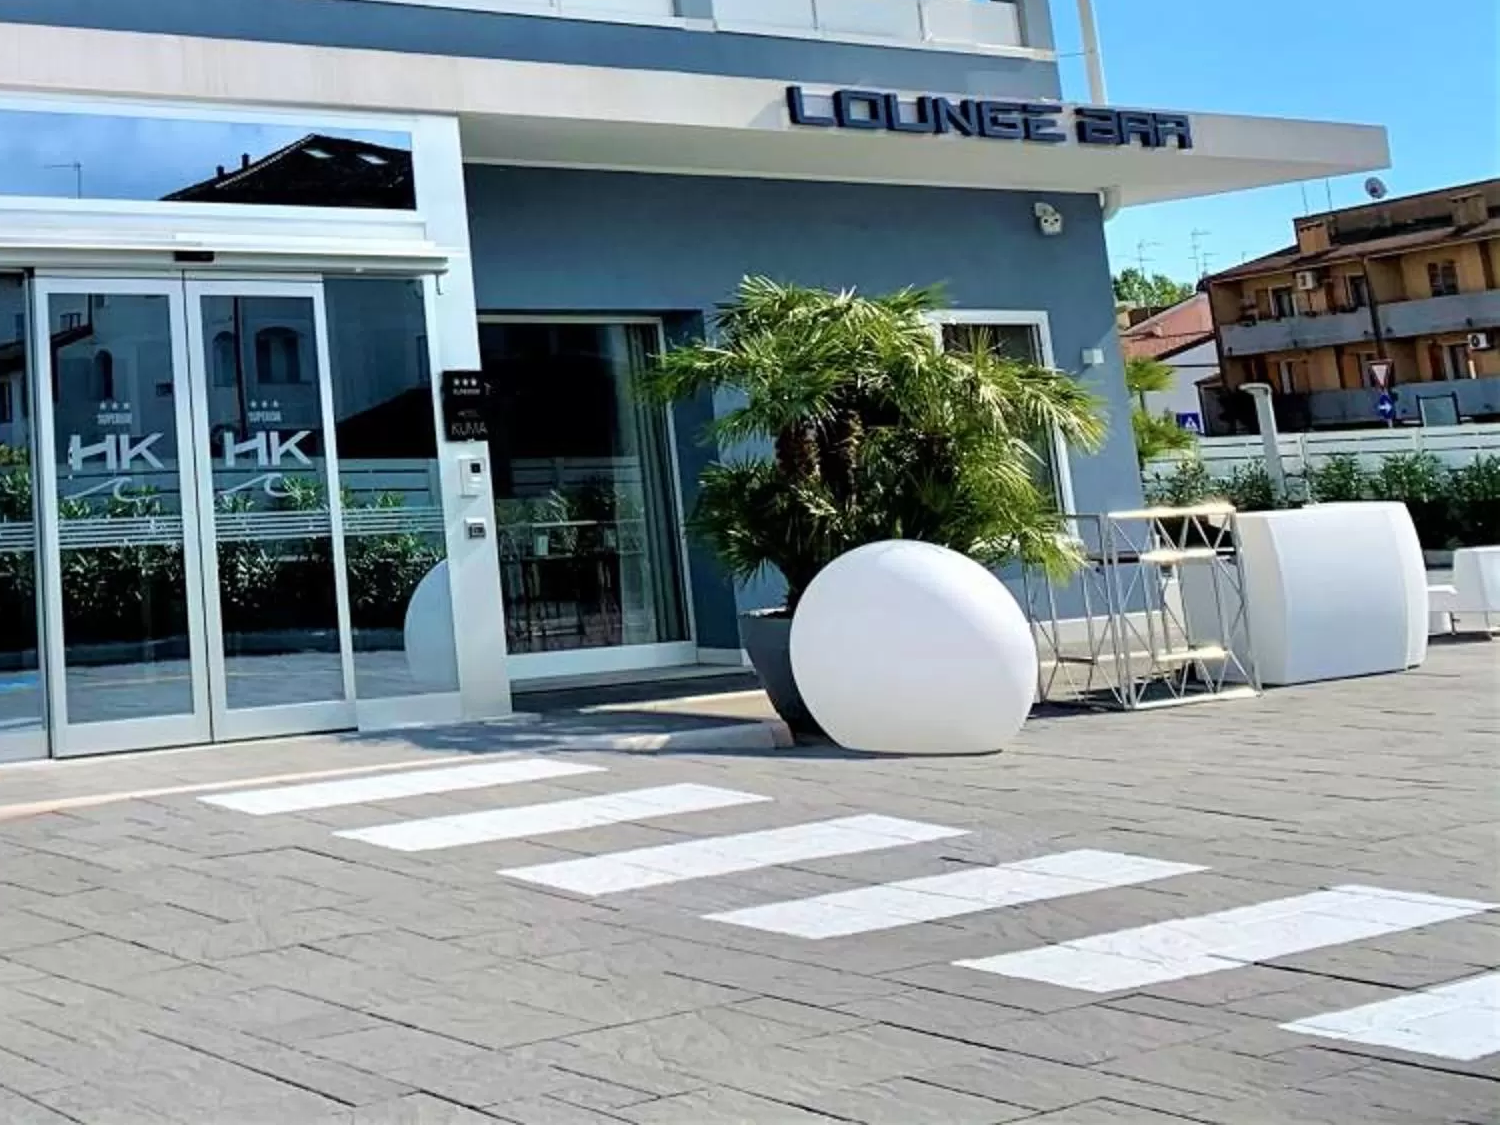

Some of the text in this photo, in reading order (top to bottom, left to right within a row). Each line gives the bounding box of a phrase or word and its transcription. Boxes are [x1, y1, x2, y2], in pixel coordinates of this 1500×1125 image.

[786, 85, 1193, 150] LOUNGE BAR
[70, 431, 165, 471] HK
[223, 430, 313, 468] HK
